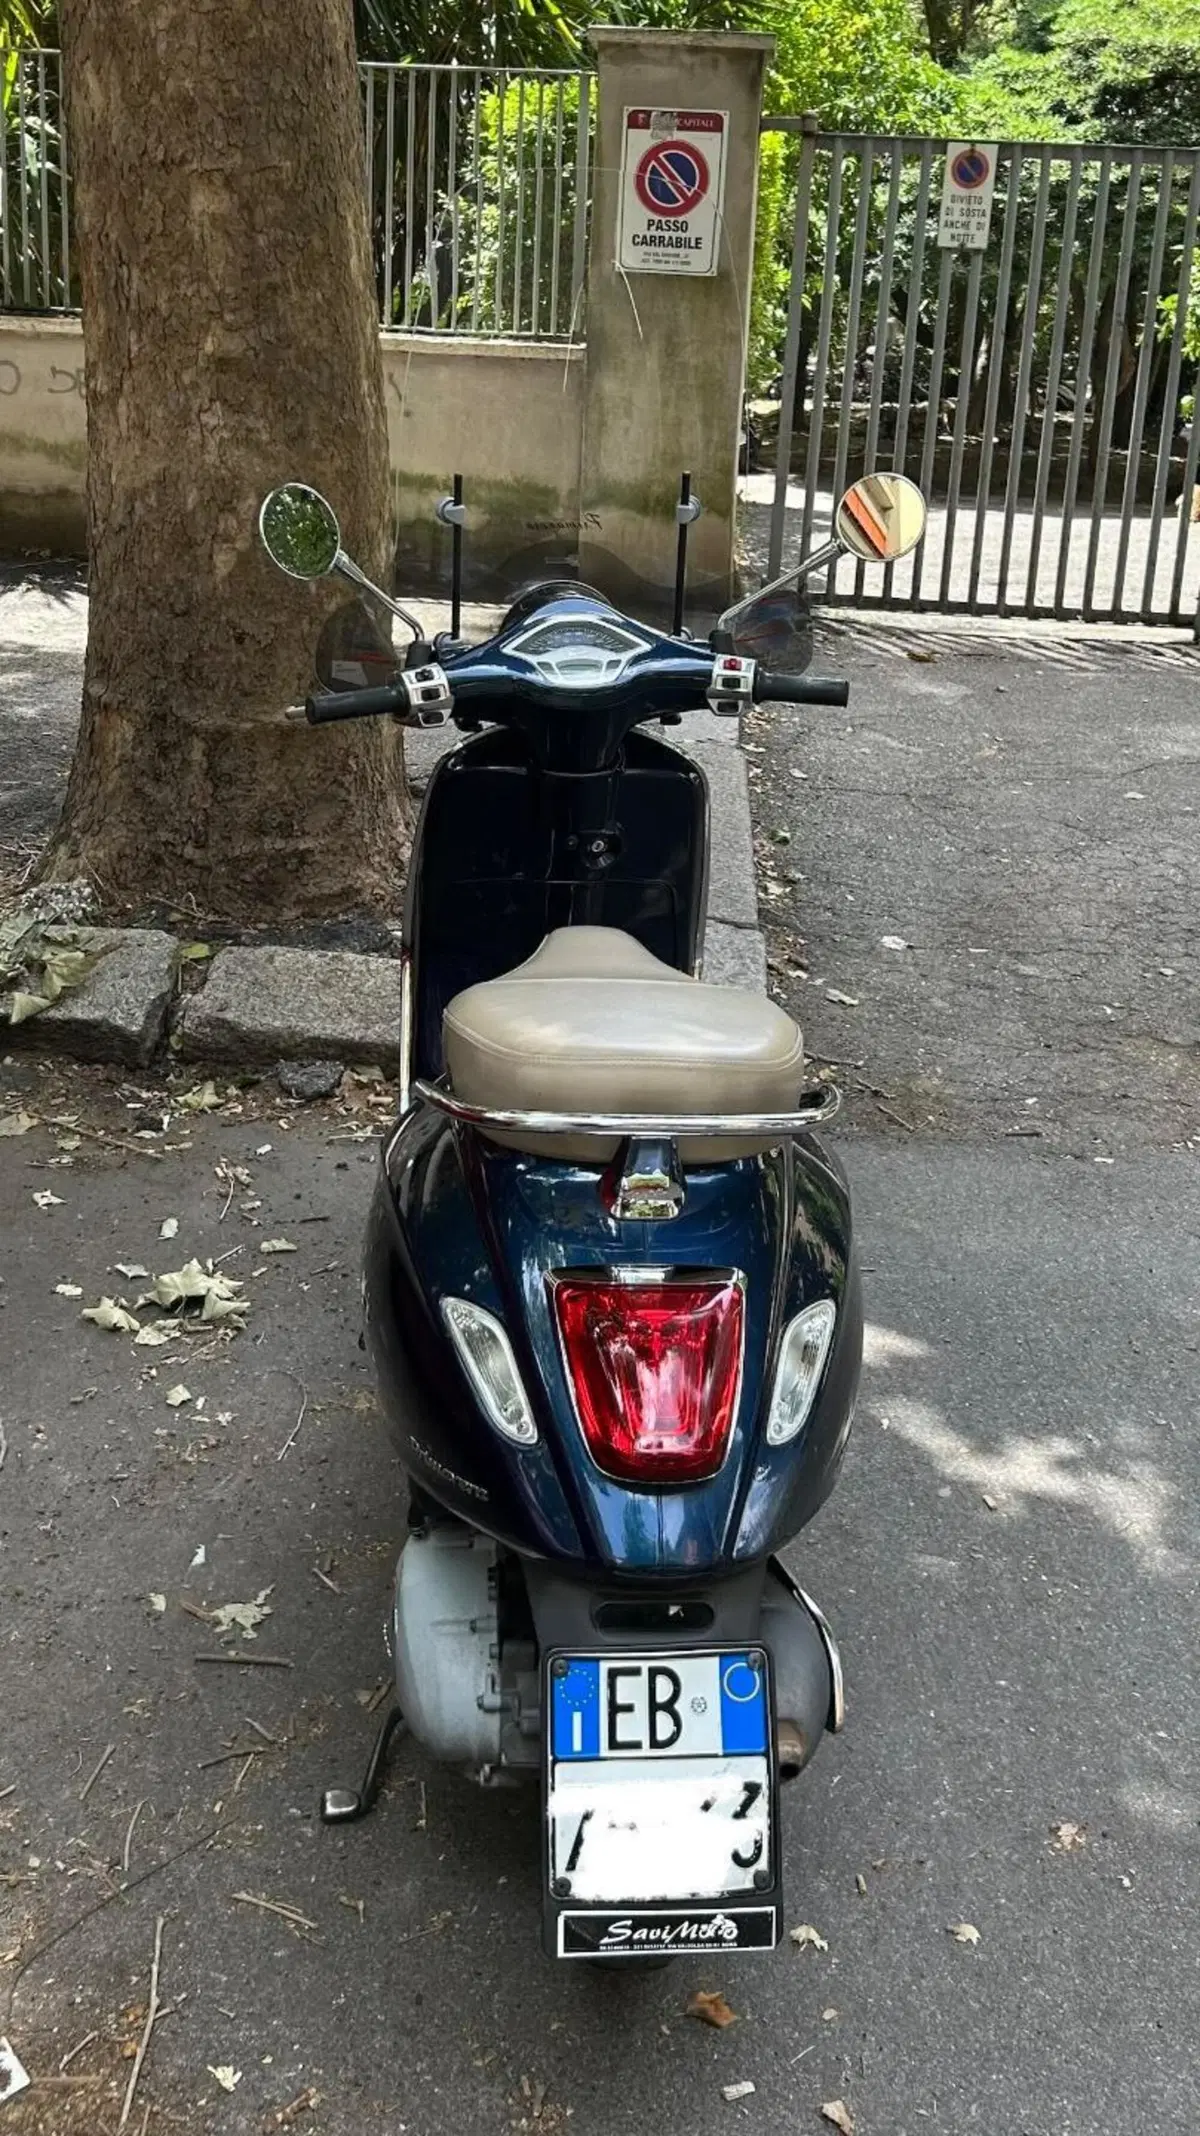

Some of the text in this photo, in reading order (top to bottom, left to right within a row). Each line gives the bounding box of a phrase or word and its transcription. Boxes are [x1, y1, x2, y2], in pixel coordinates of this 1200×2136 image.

[950, 194, 983, 205] DIVIETO
[960, 207, 986, 218] SOSTA
[647, 219, 689, 233] PASSO
[943, 220, 971, 231] ANCHE
[632, 234, 703, 250] CARRABILE
[950, 233, 976, 243] NOTTE
[607, 1665, 683, 1750] EB
[572, 1711, 582, 1752] I
